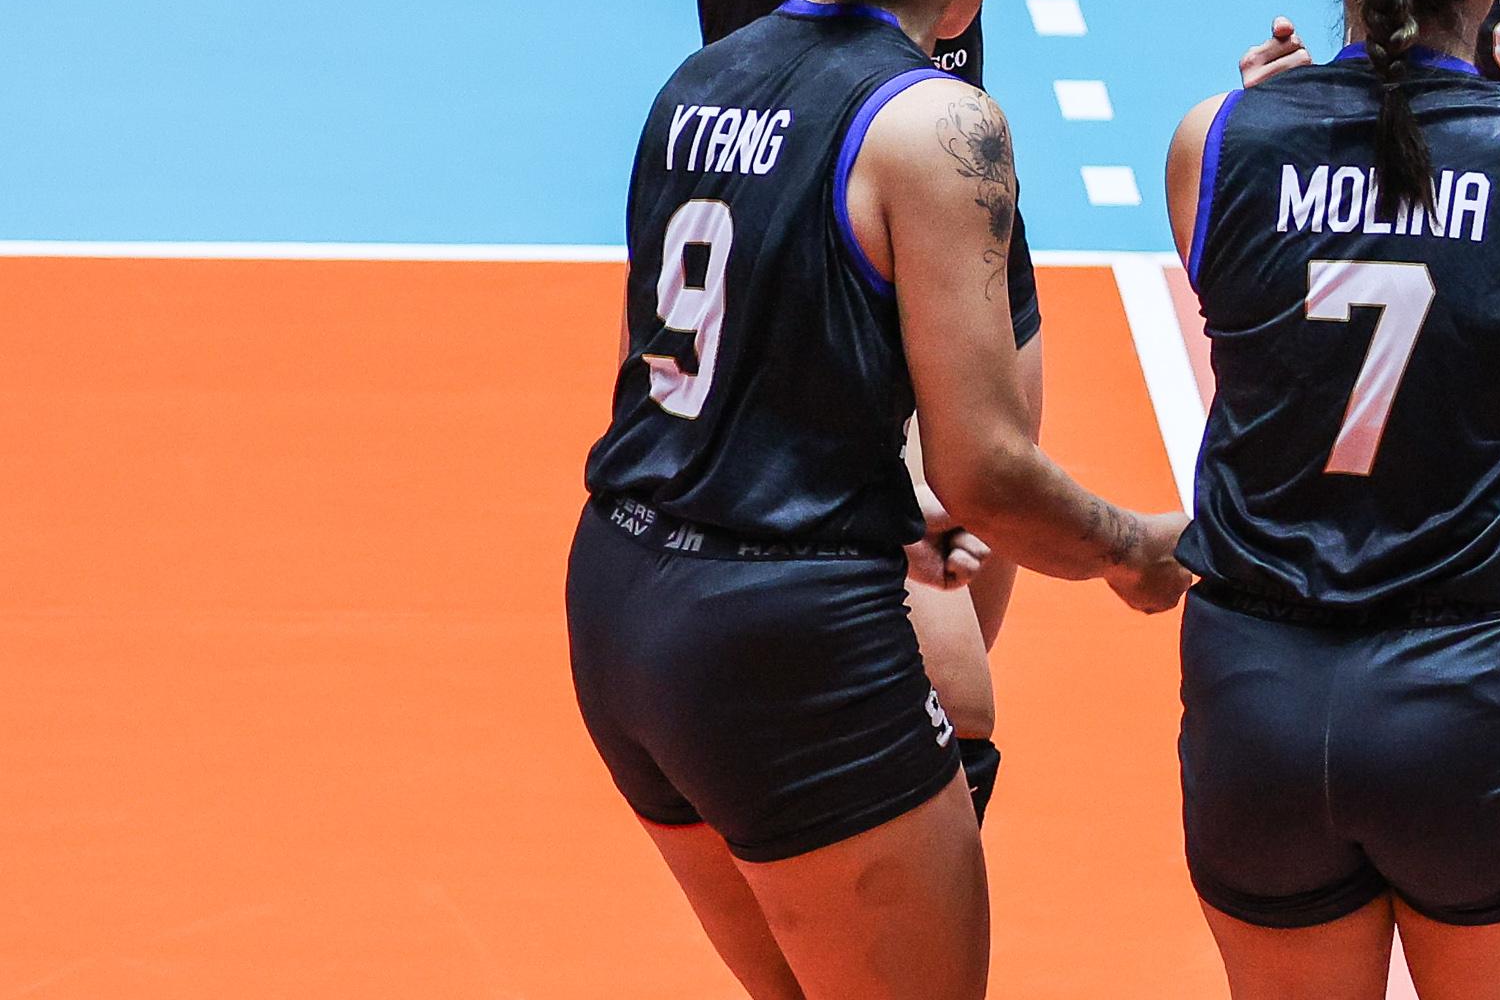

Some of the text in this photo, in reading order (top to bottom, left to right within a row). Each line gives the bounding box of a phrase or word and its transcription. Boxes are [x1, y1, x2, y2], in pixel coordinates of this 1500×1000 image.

[666, 104, 792, 175] YTANG
[1277, 164, 1490, 241] MOLINA
[642, 198, 734, 420] 9
[1304, 259, 1436, 477] 7
